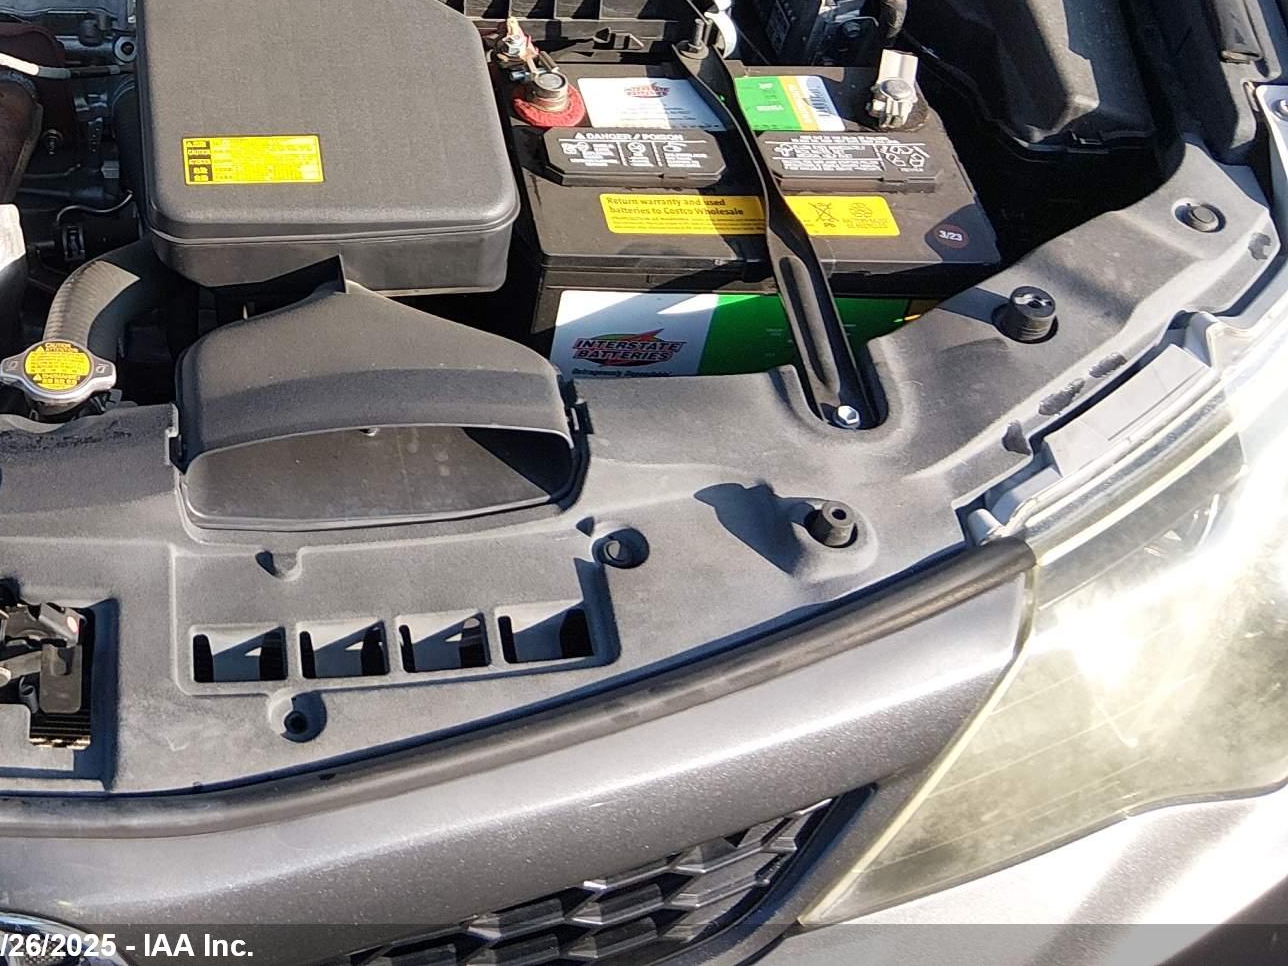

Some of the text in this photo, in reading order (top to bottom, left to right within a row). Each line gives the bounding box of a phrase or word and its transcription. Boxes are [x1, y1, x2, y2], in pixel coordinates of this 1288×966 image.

[586, 132, 633, 141] DANGER
[641, 133, 685, 142] POISON
[606, 196, 727, 207] Return warranty and used
[608, 205, 745, 216] batteries to Costco Wholesale
[938, 229, 963, 242] 3/23
[575, 340, 679, 351] INTERSTATE
[578, 350, 671, 360] BATTERIES
